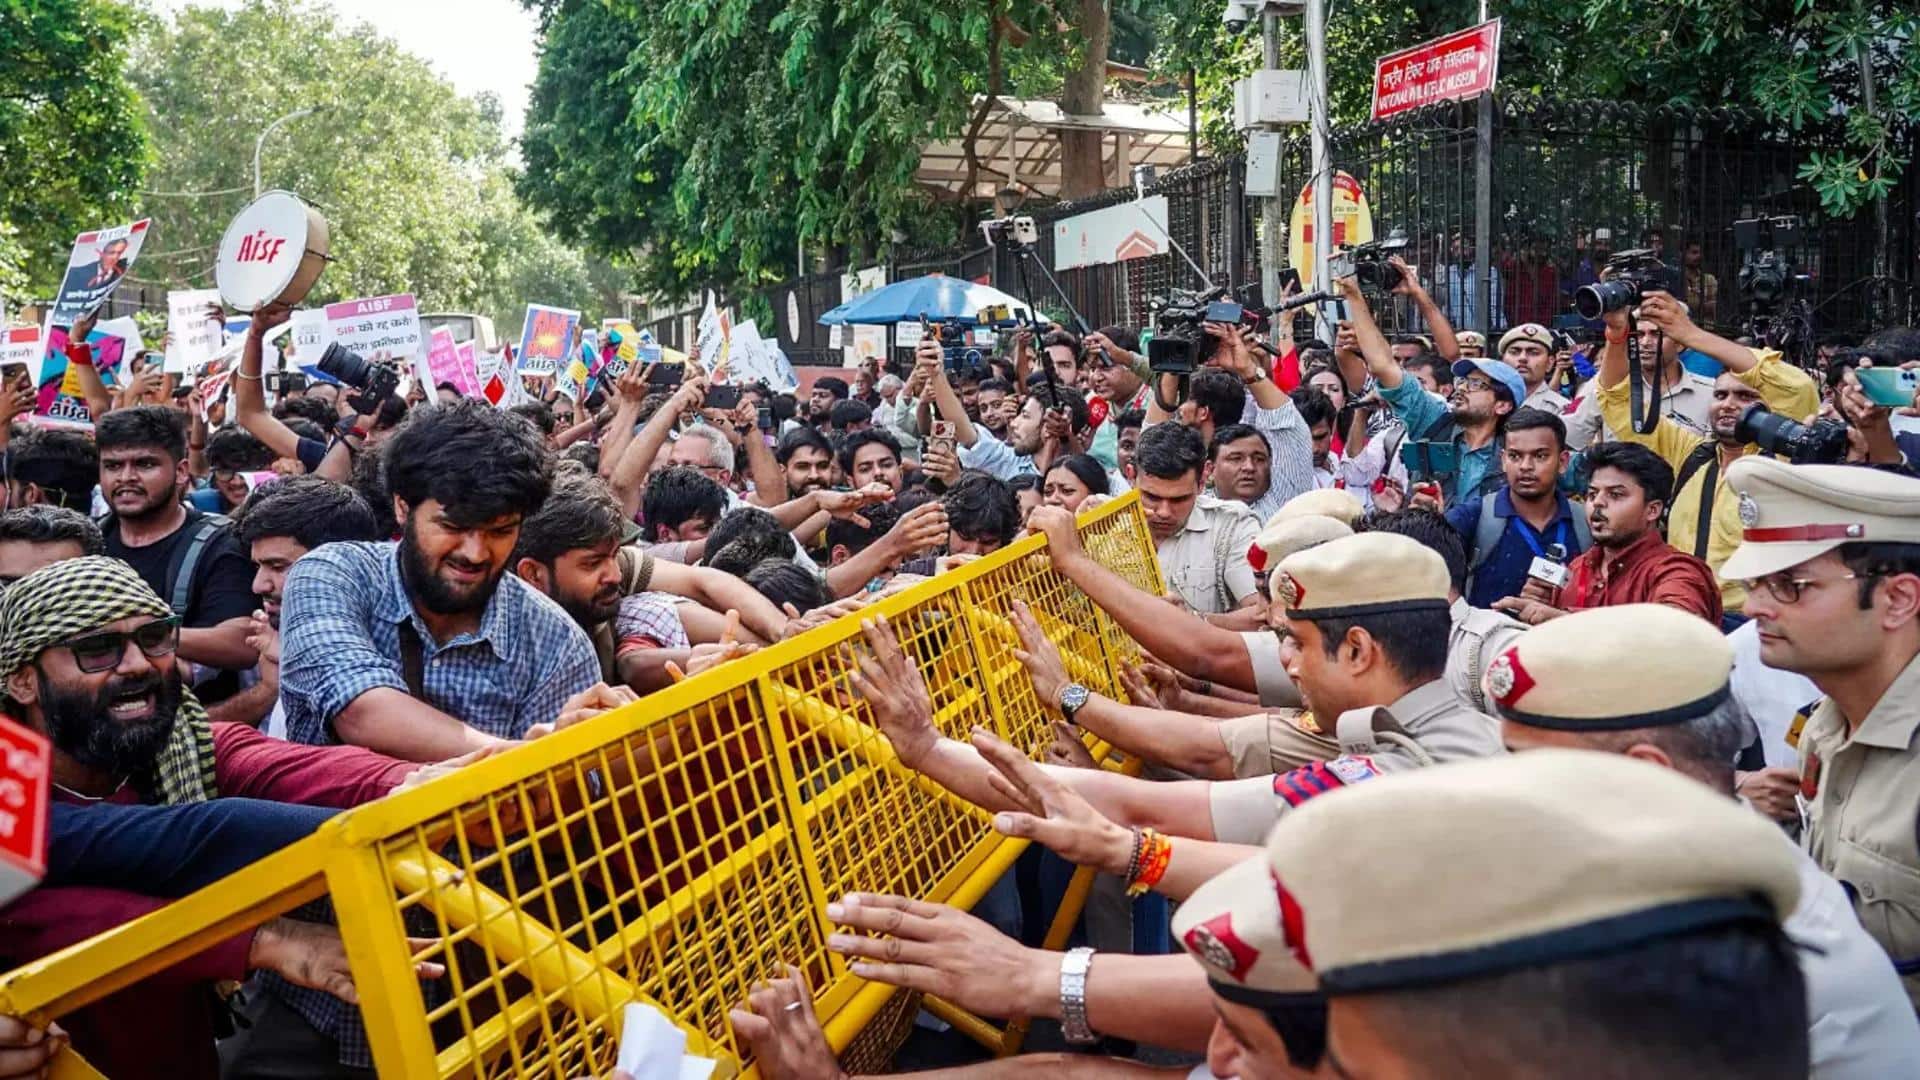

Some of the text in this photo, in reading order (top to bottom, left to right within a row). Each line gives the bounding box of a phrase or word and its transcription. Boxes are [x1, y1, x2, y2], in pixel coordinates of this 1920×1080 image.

[1379, 87, 1409, 110] NATIONAL
[1446, 70, 1477, 88] MUSEUM
[357, 298, 392, 313] AISF
[336, 325, 355, 336] SIR
[358, 319, 374, 333] को
[526, 354, 557, 370] aisa
[49, 396, 90, 420] aisa
